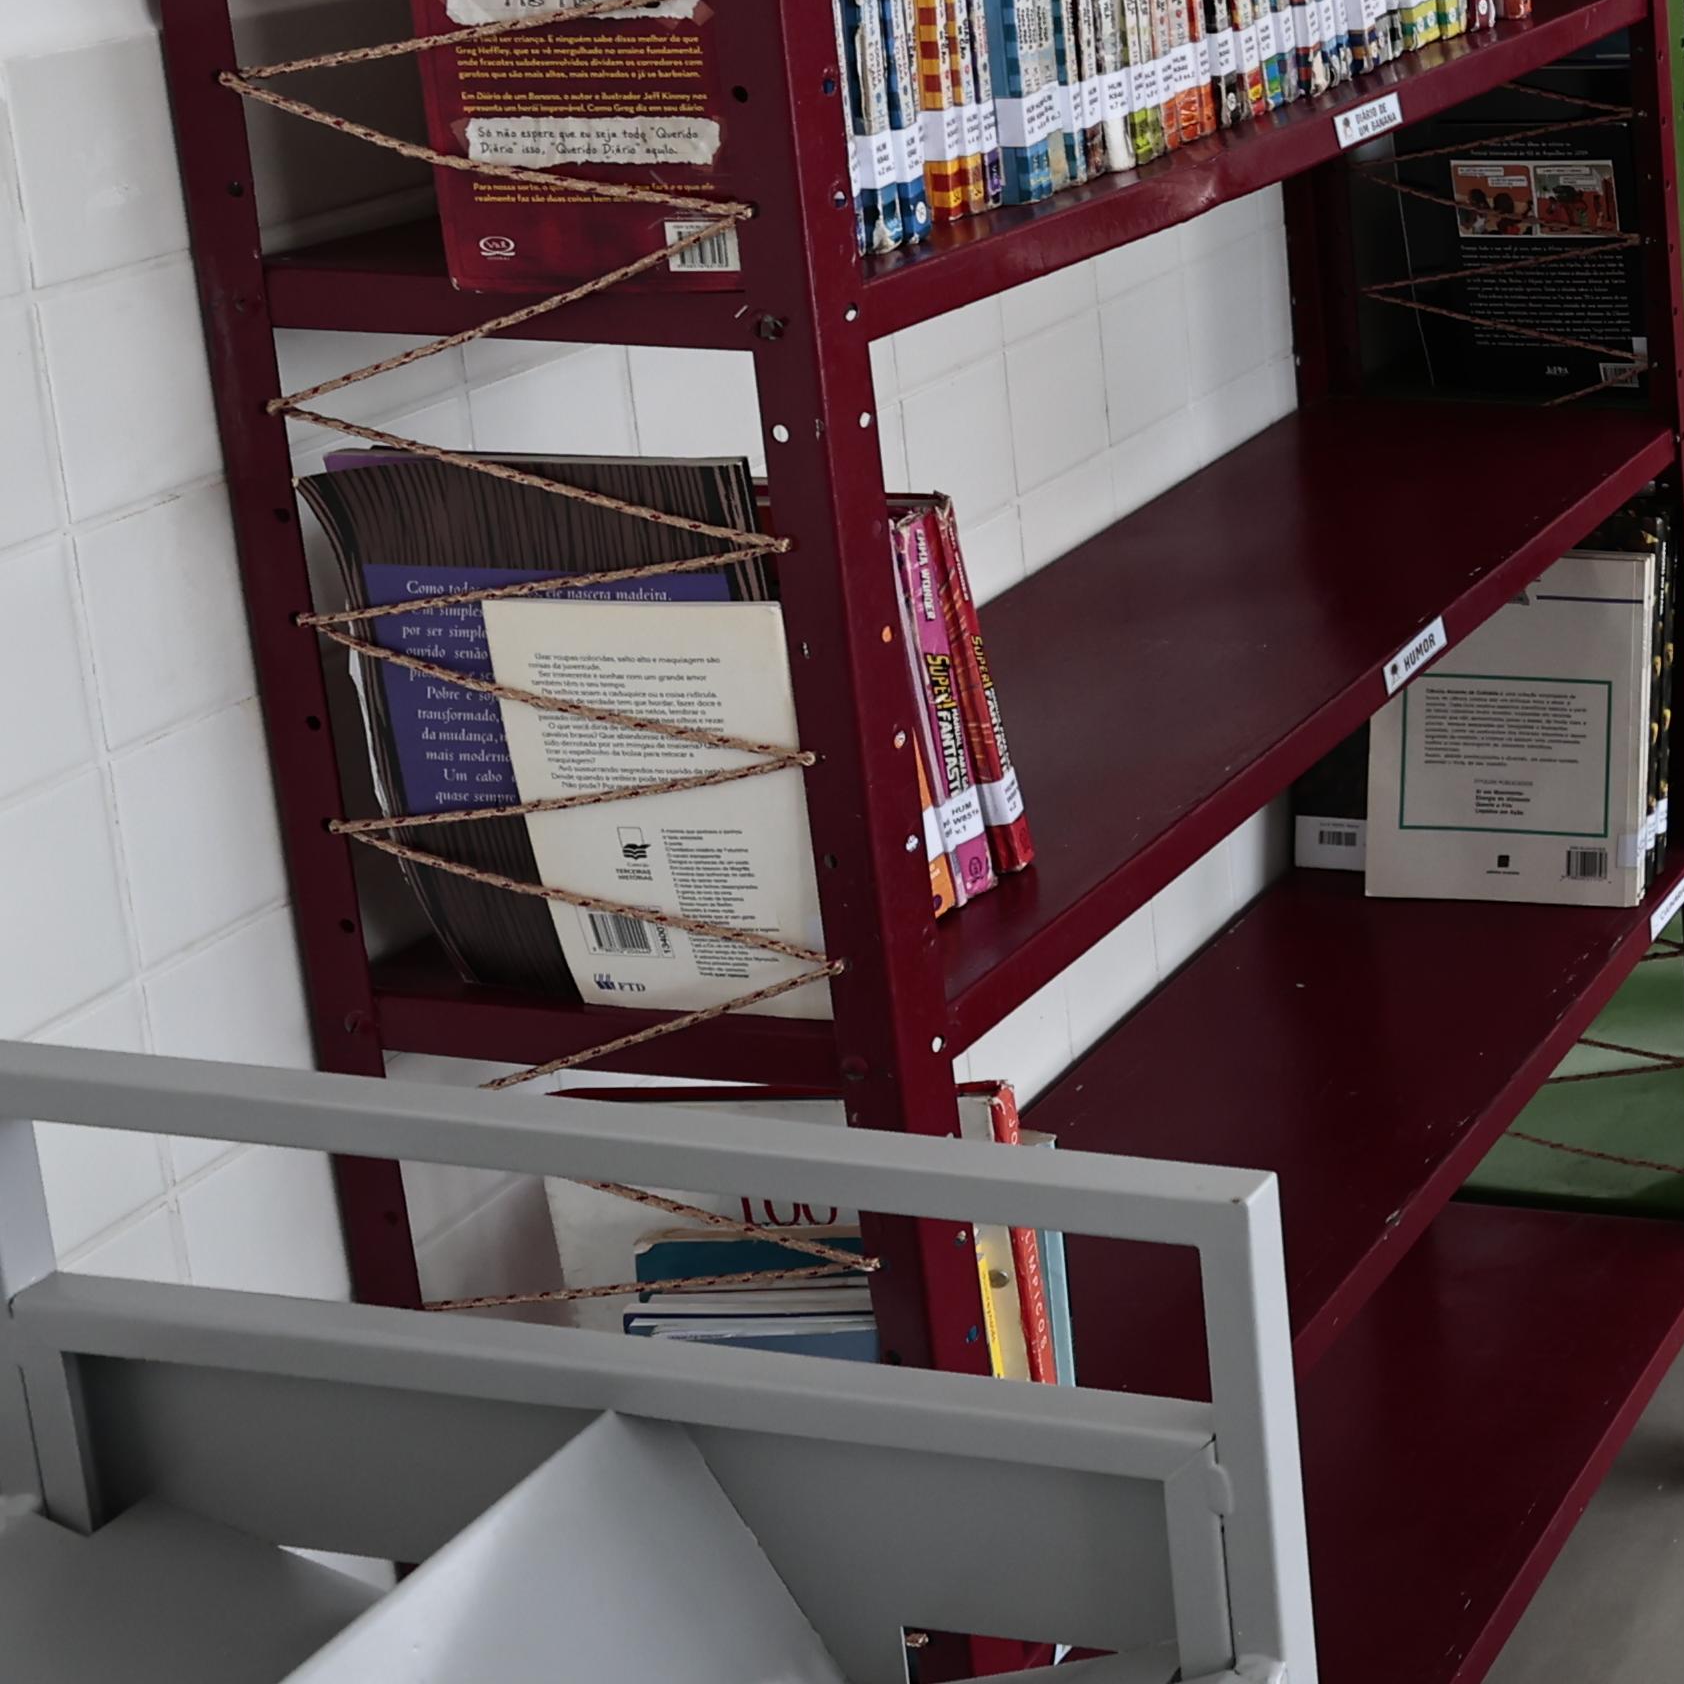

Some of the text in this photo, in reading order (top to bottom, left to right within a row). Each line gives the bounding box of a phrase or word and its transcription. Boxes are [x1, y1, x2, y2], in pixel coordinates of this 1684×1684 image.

[478, 126, 492, 137] Só
[496, 128, 517, 137] não
[521, 130, 554, 142] espere
[559, 131, 575, 142] que
[596, 129, 617, 142] seja
[522, 145, 546, 155] isso,
[406, 580, 671, 602] Como nascera madeira.
[918, 567, 939, 621] WONDER
[403, 625, 442, 639] por ser
[406, 644, 488, 660] ouvido senão
[1403, 633, 1436, 672] HUMOR
[427, 686, 472, 701] Pobre e
[417, 707, 500, 724] transformado,
[421, 726, 498, 744] da mudança,
[425, 749, 454, 761] mais
[443, 768, 503, 782] Um cabo
[435, 791, 516, 804] quase sempre
[618, 981, 646, 992] FTD
